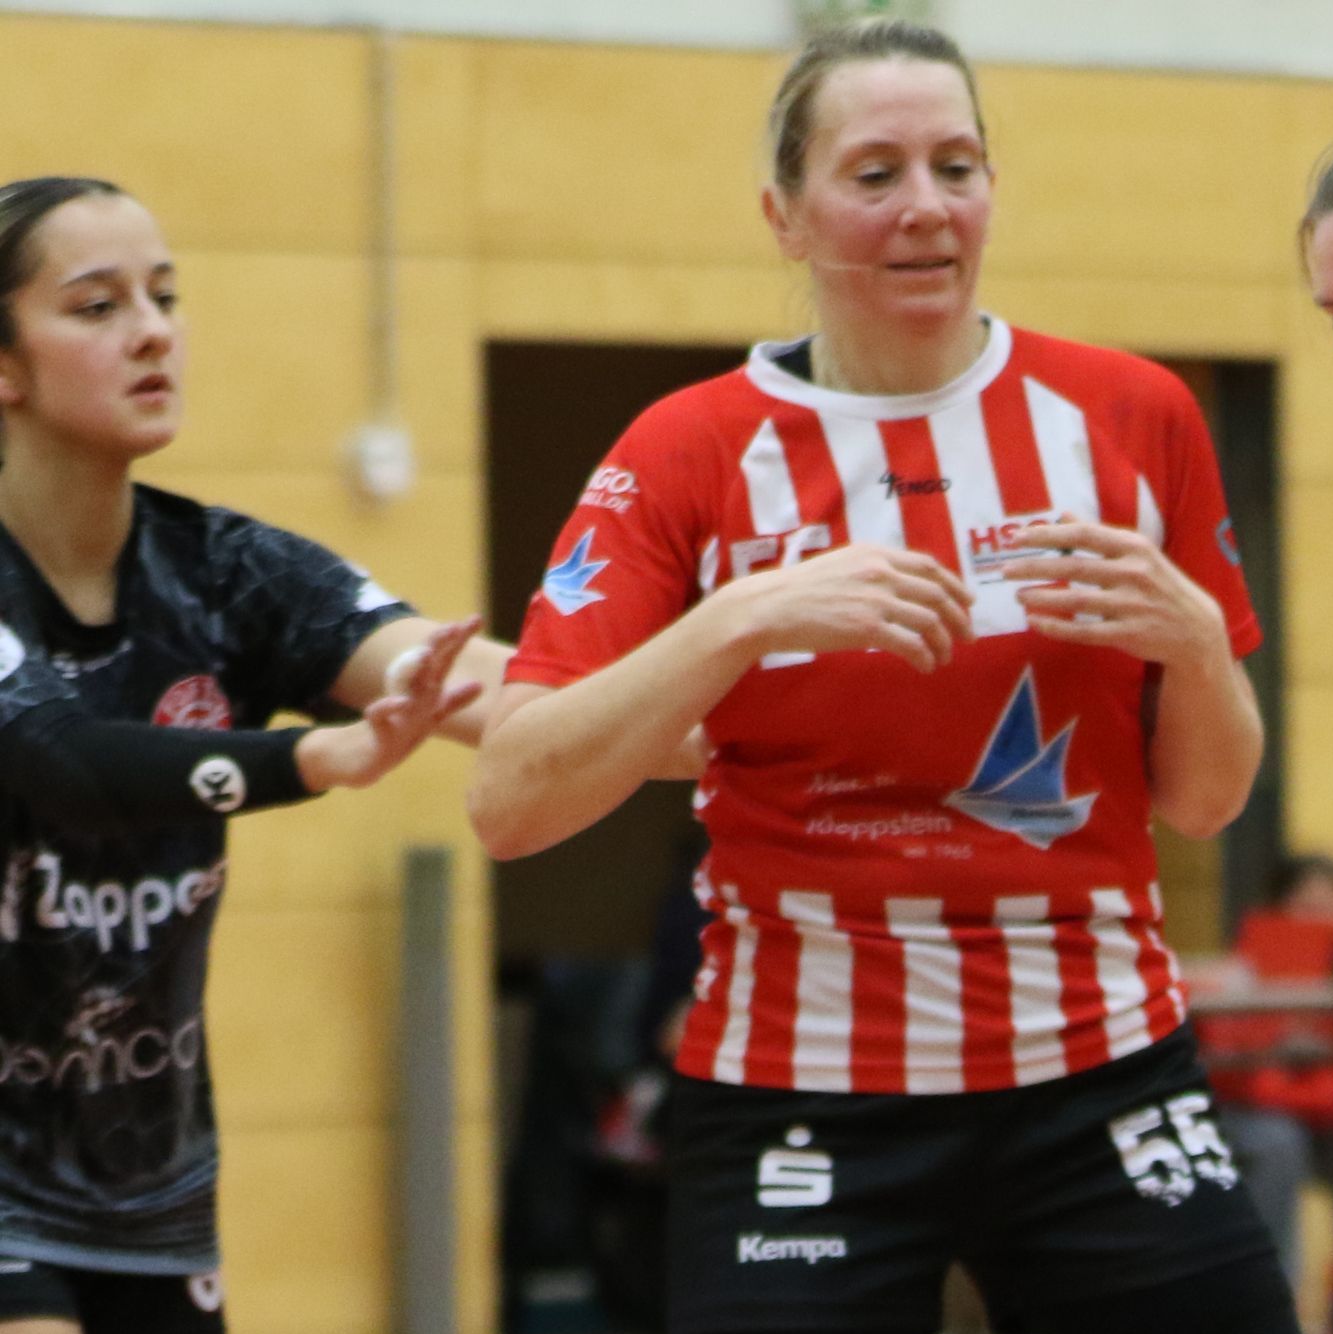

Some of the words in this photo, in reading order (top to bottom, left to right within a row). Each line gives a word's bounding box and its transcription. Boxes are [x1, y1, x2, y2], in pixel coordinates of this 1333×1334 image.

[968, 519, 1049, 557] HS
[1109, 1093, 1238, 1208] 55
[738, 1233, 848, 1265] Kempa
